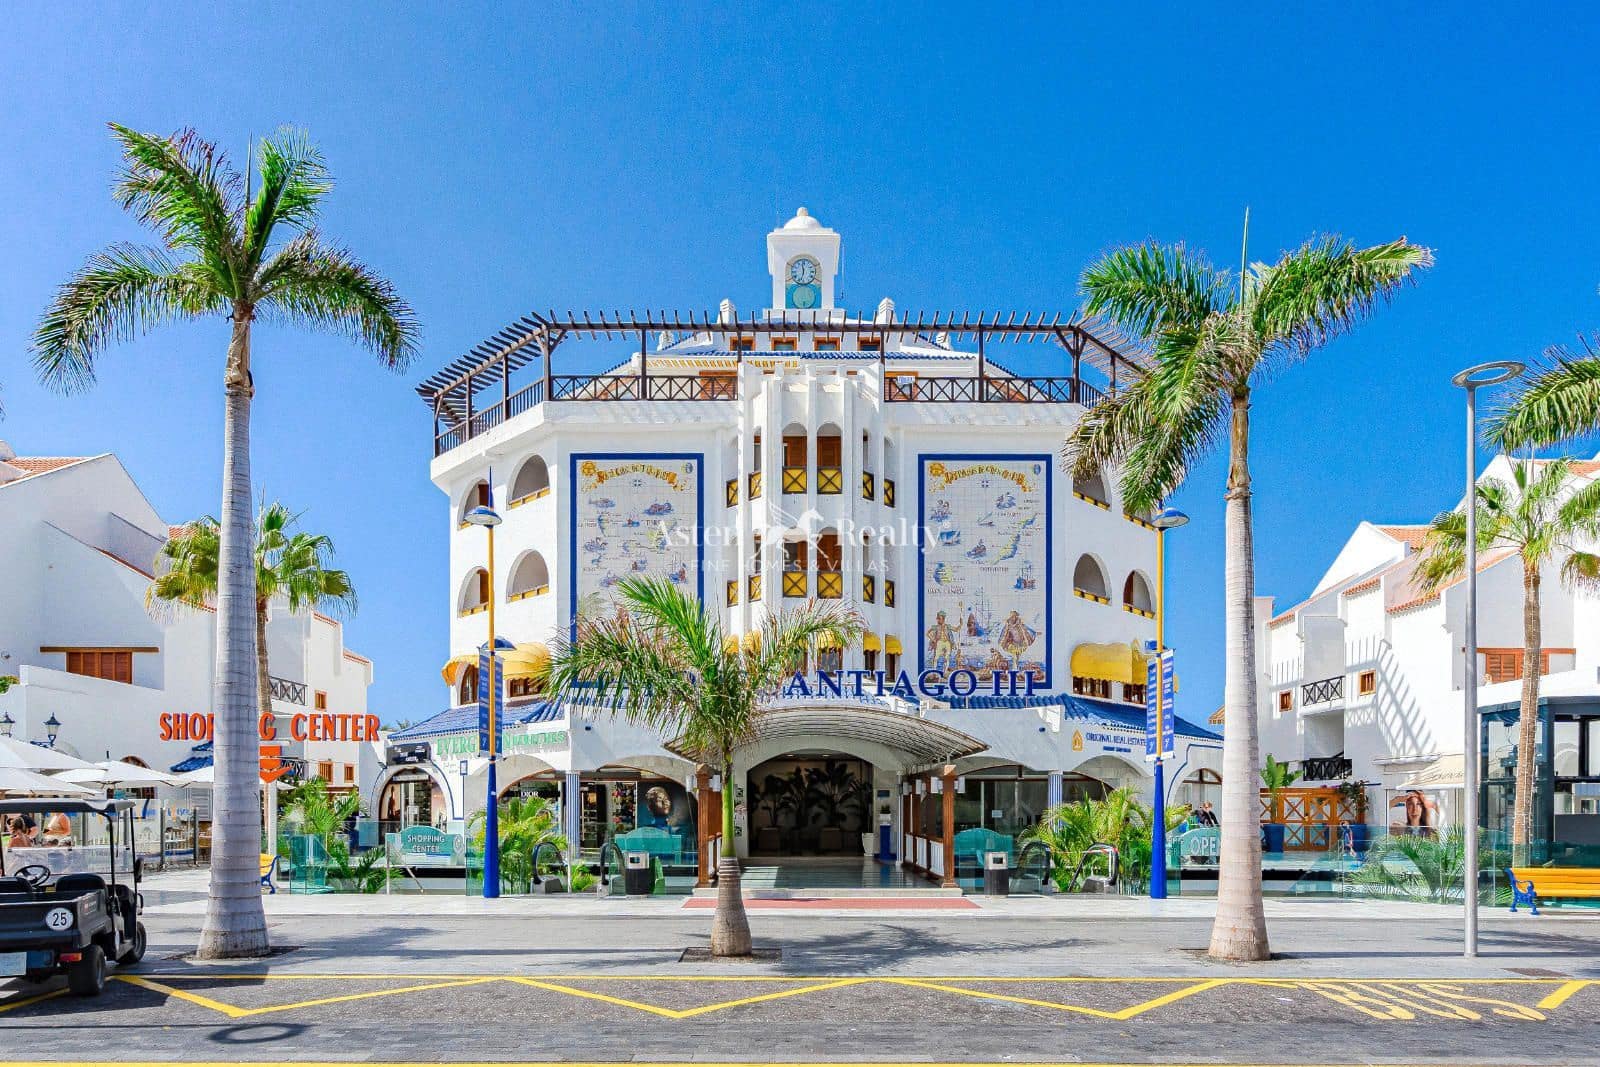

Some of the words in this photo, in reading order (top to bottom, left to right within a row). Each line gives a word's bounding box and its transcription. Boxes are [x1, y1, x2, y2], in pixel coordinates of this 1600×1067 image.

[785, 669, 977, 697] ANTIAGO
[991, 670, 1036, 697] III
[290, 712, 380, 742] CENTER
[521, 790, 539, 798] DIOR
[407, 834, 445, 843] SHOPPING
[413, 844, 440, 853] CENTER
[52, 912, 68, 927] 25
